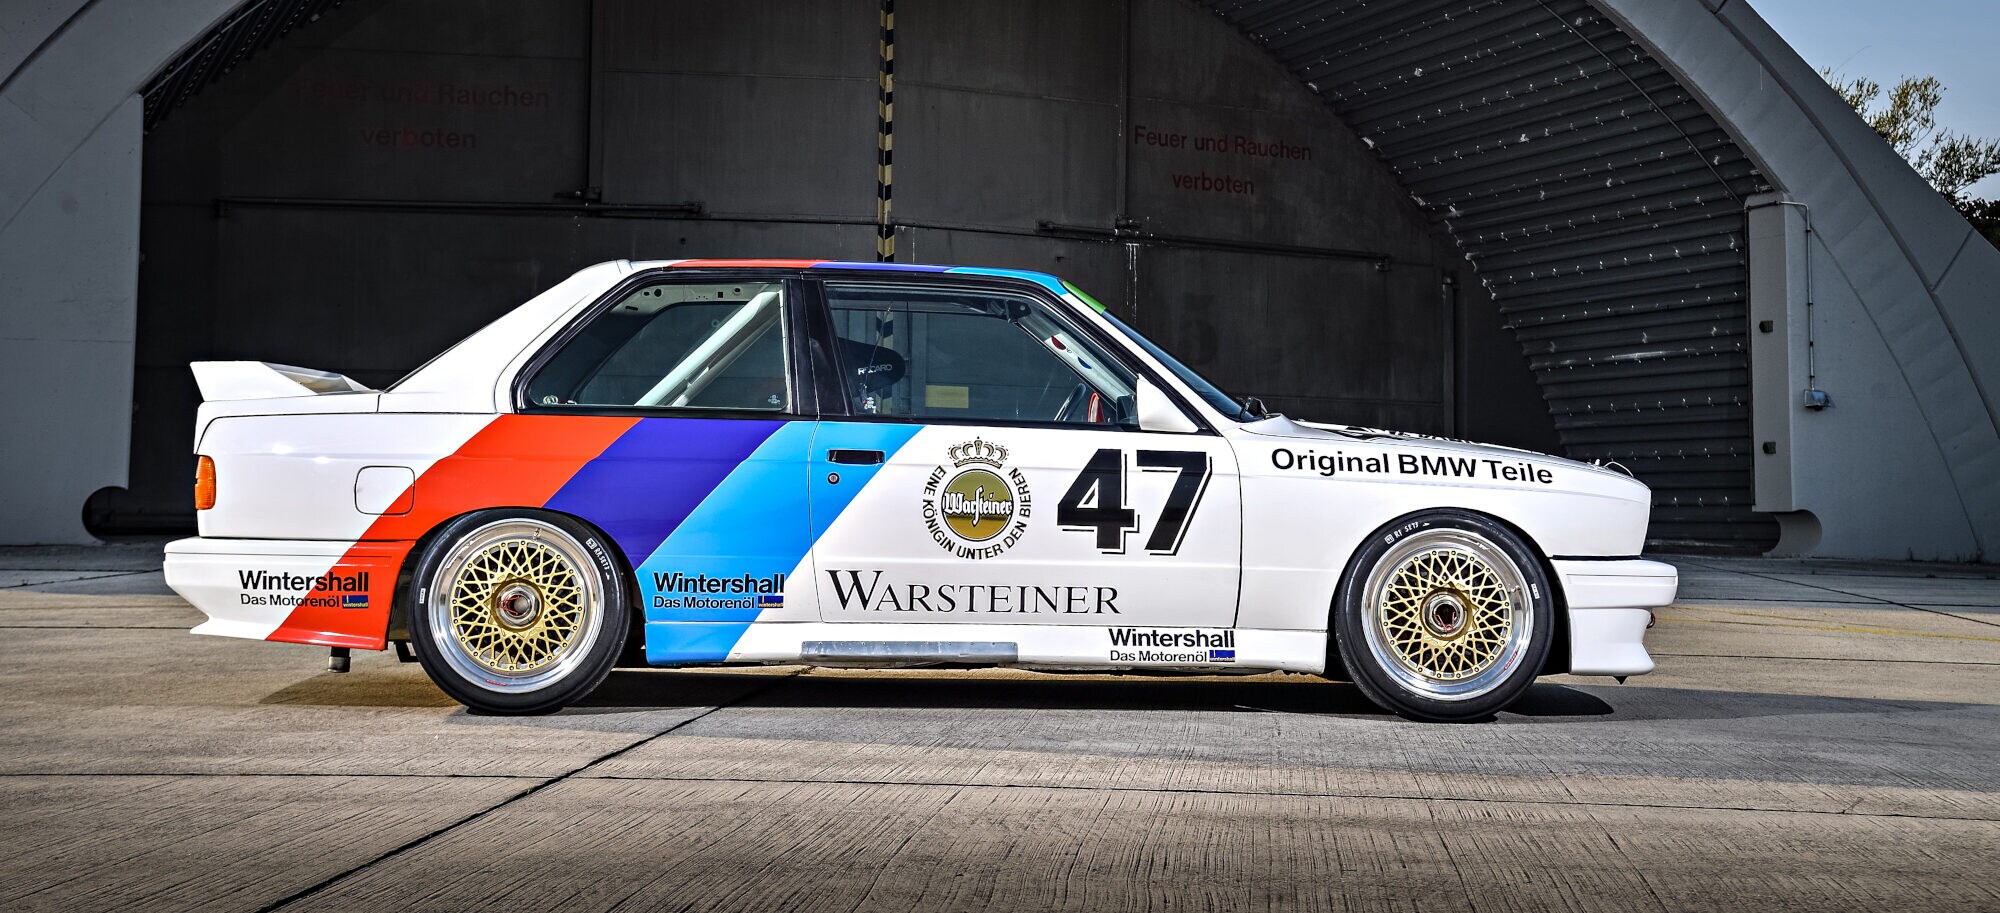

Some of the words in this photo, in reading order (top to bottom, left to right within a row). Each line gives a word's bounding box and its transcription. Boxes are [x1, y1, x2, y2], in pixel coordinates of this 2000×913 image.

[382, 81, 429, 104] und
[439, 84, 549, 107] Rauchen
[360, 126, 476, 149] verboten
[1134, 125, 1186, 148] Feuer
[1195, 134, 1228, 153] und
[1235, 136, 1311, 161] Rauchen
[1172, 172, 1254, 195] verboten
[1271, 448, 1390, 476] Original
[1398, 453, 1477, 479] BMW
[1482, 459, 1554, 485] Teile
[922, 465, 947, 497] EINE
[1008, 467, 1032, 519] BIEREN
[943, 485, 1013, 527] Warsteiner
[1057, 447, 1213, 556] 47
[922, 498, 956, 553] KÖNIGIN
[1003, 521, 1028, 549] DEN
[956, 543, 1004, 560] UNTER
[238, 570, 369, 592] Wintershall
[653, 572, 785, 594] Wintershall
[825, 569, 1122, 615] WARSTEINER
[240, 593, 267, 605] Das
[269, 594, 340, 608] Motorenöl
[654, 596, 680, 608] Das
[683, 596, 755, 609] Motorenöl
[1108, 628, 1236, 648] Wintershall
[1110, 650, 1136, 661] Das
[1138, 650, 1207, 662] Motorenöl
